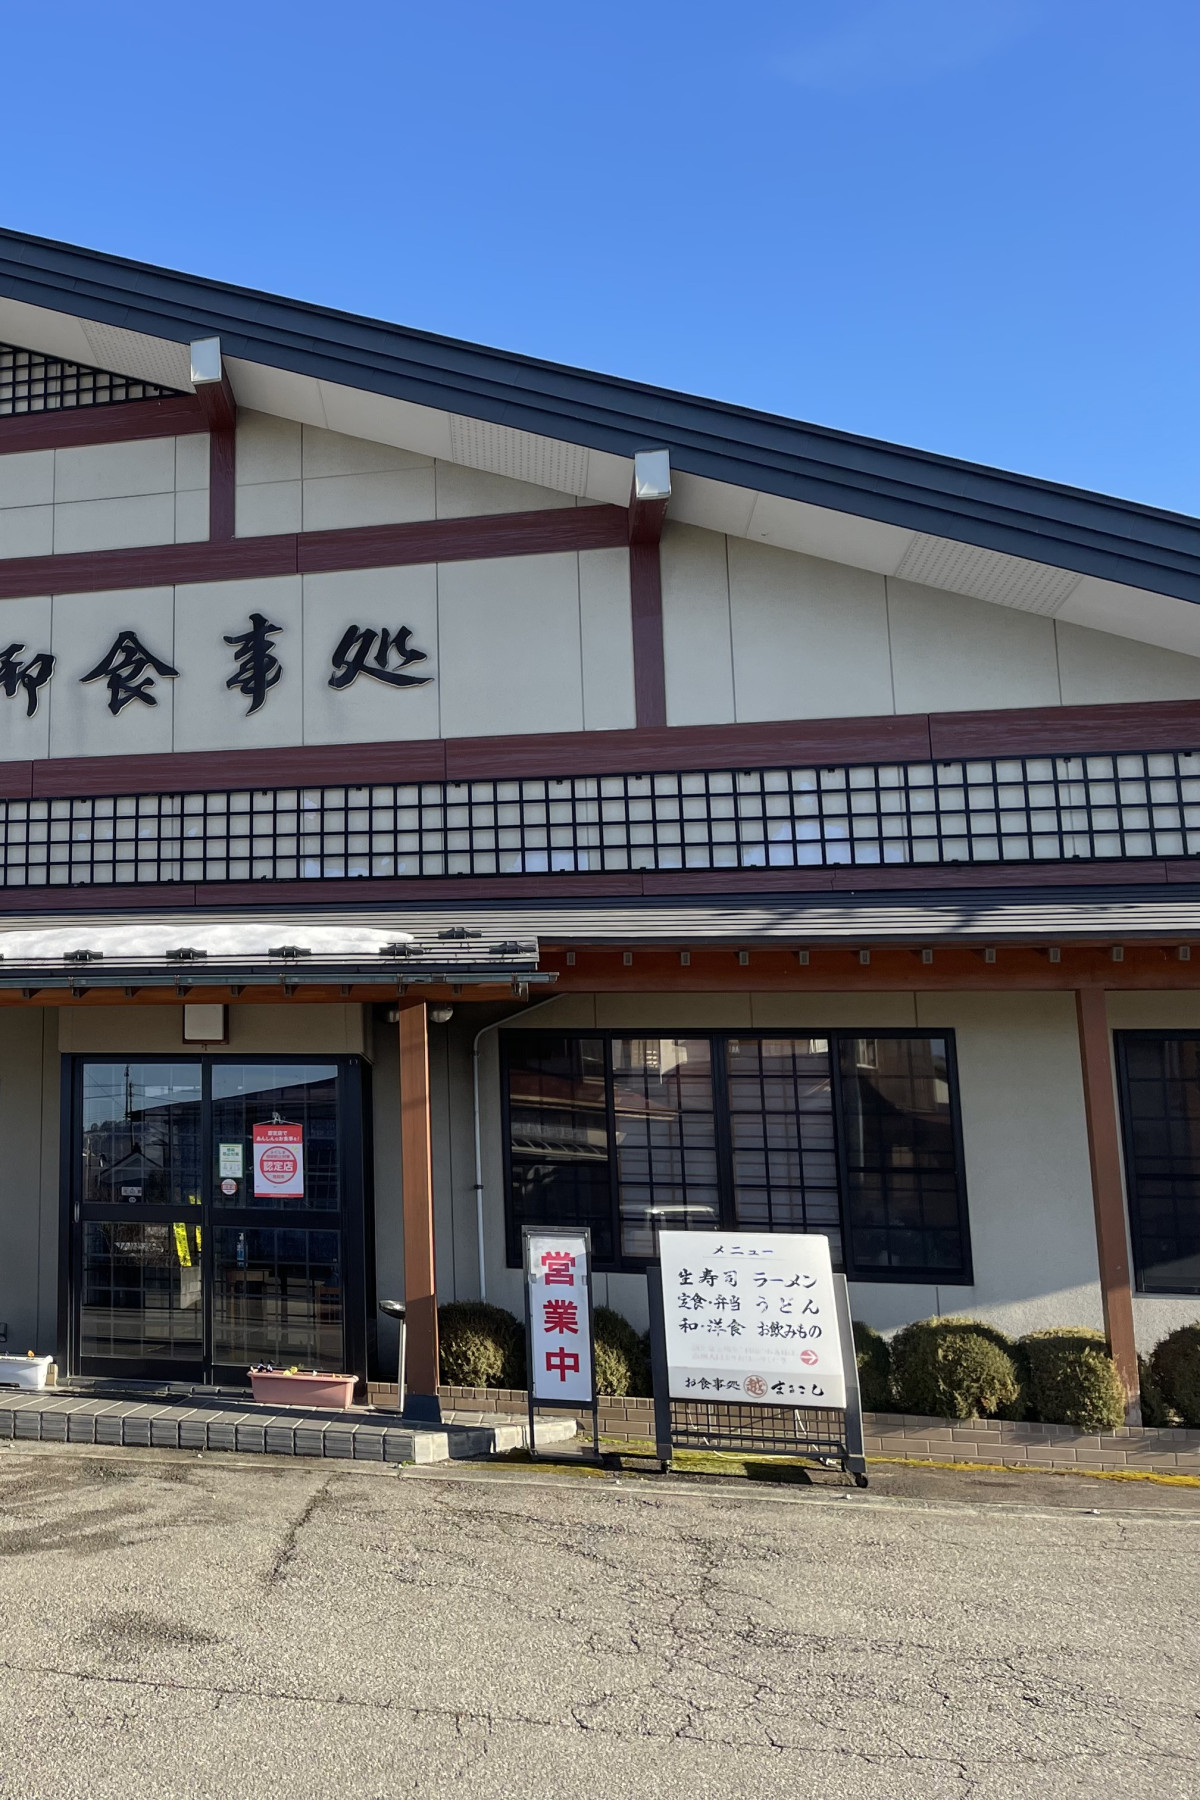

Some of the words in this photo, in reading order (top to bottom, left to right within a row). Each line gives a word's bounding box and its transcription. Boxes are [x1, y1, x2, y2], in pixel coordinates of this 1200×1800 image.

[263, 1161, 294, 1172] 認定店
[712, 1245, 774, 1256] メニュー
[678, 1267, 738, 1287] 生寿司
[752, 1271, 818, 1289] ラーメン
[677, 1292, 741, 1312] 定食・弁当
[755, 1295, 820, 1315] うどん
[540, 1250, 581, 1383] 営業中
[678, 1317, 746, 1337] 和・洋食
[756, 1320, 823, 1339] お飲みもの
[685, 1377, 741, 1391] お食事処
